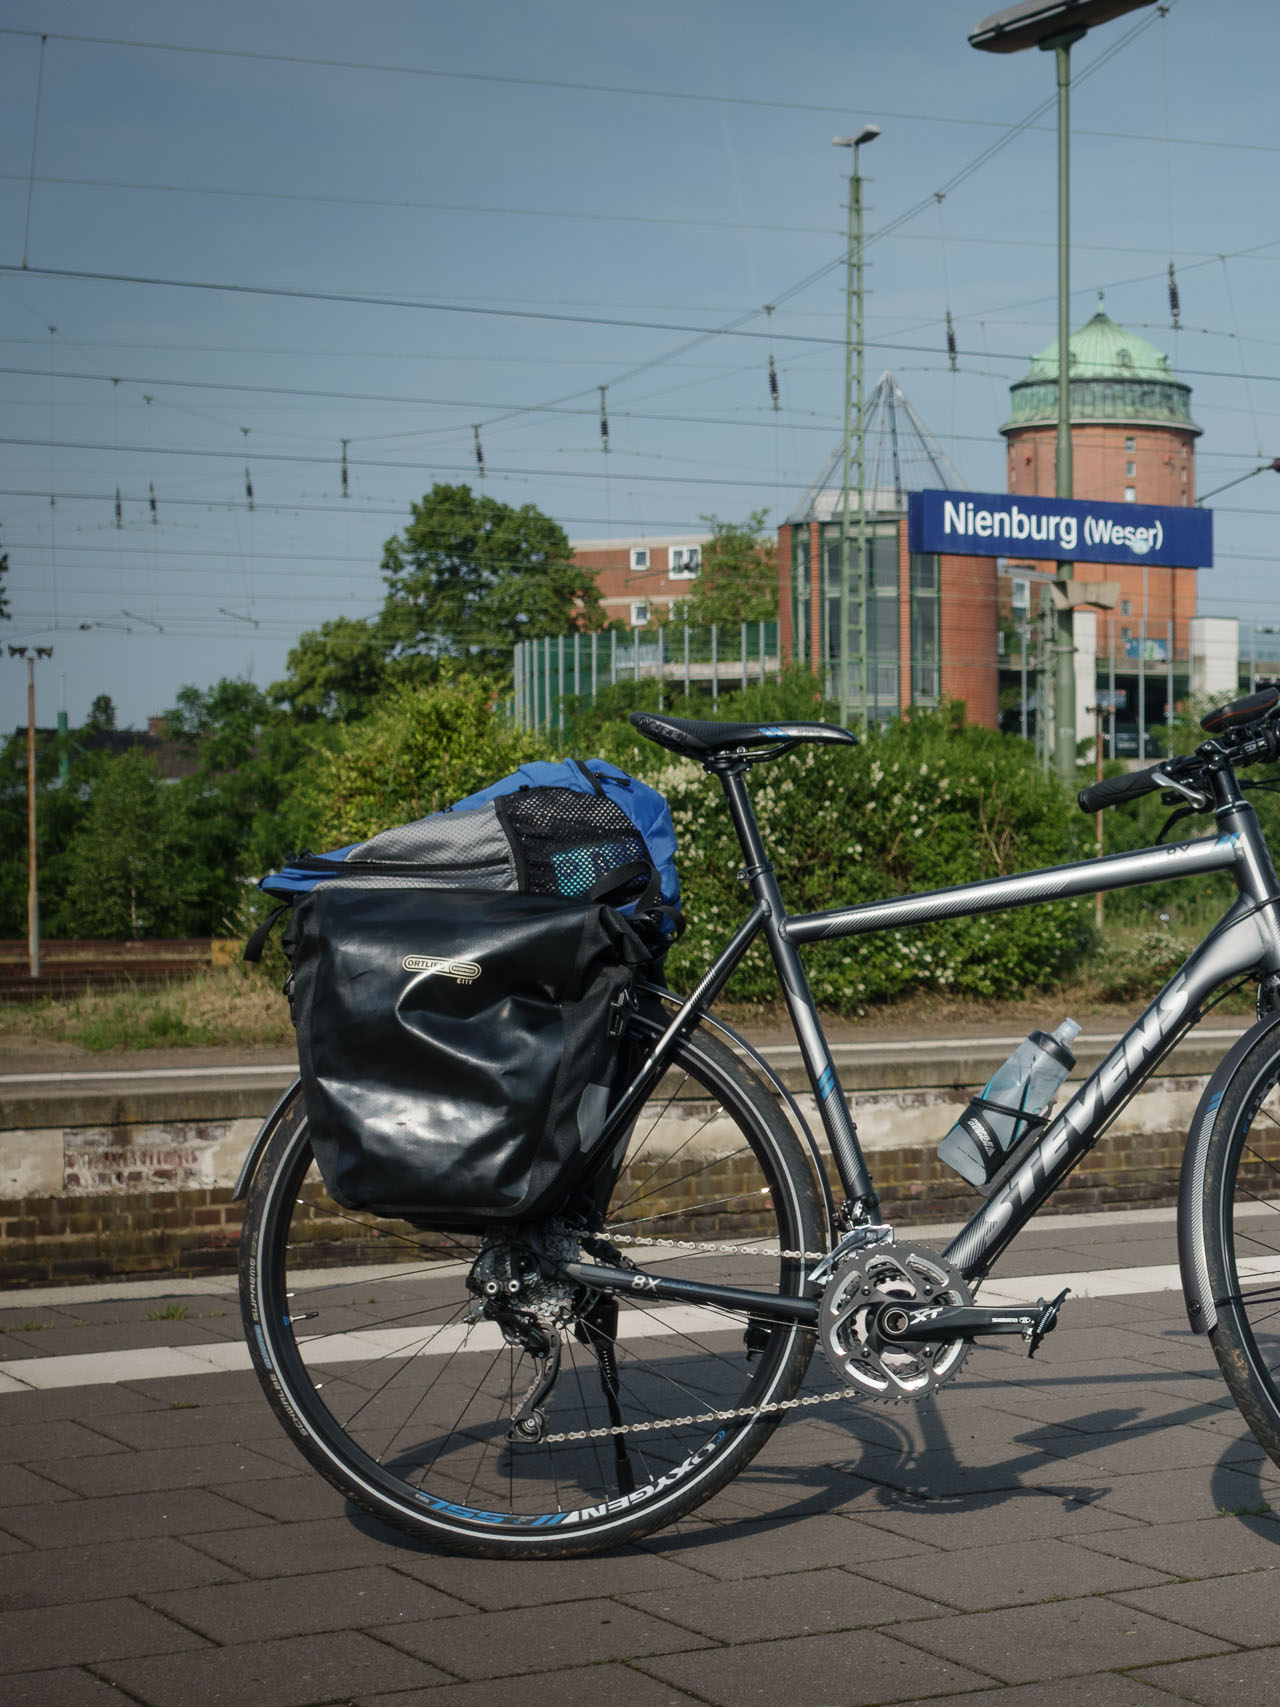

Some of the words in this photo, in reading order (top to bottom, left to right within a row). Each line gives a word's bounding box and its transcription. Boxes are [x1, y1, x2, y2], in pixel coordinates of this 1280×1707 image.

[944, 501, 1078, 550] Nienburg
[1083, 516, 1164, 551] (Weser)
[407, 960, 446, 970] ORTLIE
[985, 973, 1190, 1247] STEVENS
[631, 1275, 662, 1292] 8X
[909, 1307, 943, 1325] XT
[582, 1442, 717, 1520] OXYGEN
[418, 1490, 512, 1524] SSL
